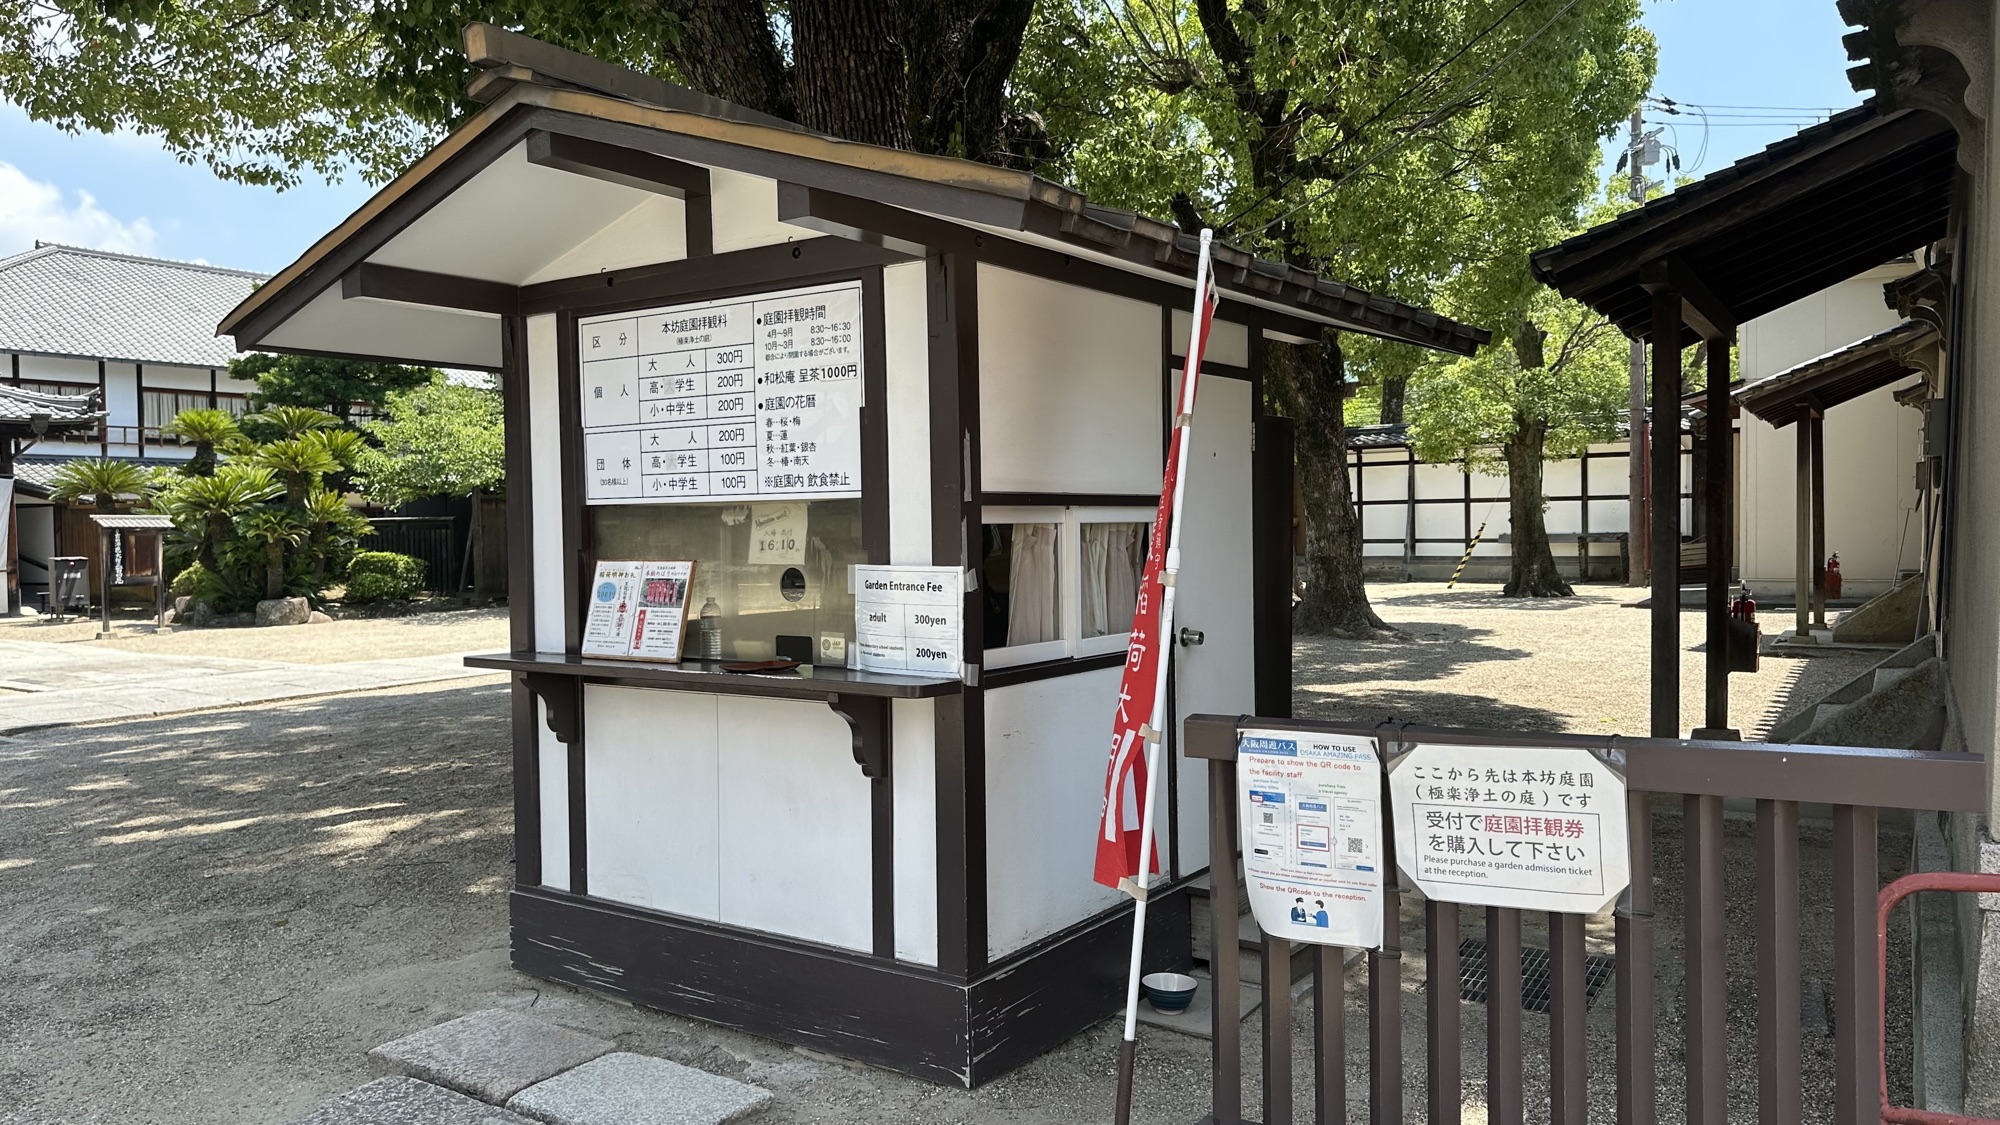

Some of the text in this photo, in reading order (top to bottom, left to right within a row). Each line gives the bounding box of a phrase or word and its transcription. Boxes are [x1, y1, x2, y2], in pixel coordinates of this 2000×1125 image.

[763, 305, 826, 326] 庭園拝観時間
[661, 314, 727, 334] 本坊庭園拝観料
[592, 332, 628, 348] 区 分
[648, 354, 695, 372] 大 人
[716, 350, 743, 364] 300円
[717, 373, 743, 388] 200円
[593, 384, 629, 399] 個 人
[650, 401, 696, 417] 小・中学生
[717, 397, 744, 411] 200円
[765, 394, 816, 411] 庭園の花暦
[650, 431, 697, 447] 大 人
[718, 428, 745, 442] 200円
[596, 457, 632, 471] 団 体
[720, 452, 745, 465] 100円
[652, 477, 698, 492] 小・中学生
[721, 475, 746, 489] 100円
[807, 472, 850, 487] 飲食禁止
[865, 579, 943, 592] Garden Entrance Fee
[869, 612, 887, 623] adult
[914, 614, 947, 627] 300yen
[916, 647, 947, 660] 200yen
[1241, 738, 1296, 751] 大阪周遊パス
[1313, 743, 1330, 751] HOW
[1342, 745, 1356, 753] USE
[1300, 749, 1321, 757] OSAKA
[1323, 751, 1353, 760] AMAZING
[1249, 756, 1276, 766] Prepare
[1306, 759, 1318, 767] the
[1333, 762, 1351, 770] code
[1262, 769, 1284, 778] facility
[1414, 766, 1594, 789] ここから先は本坊庭園
[1415, 783, 1592, 808] （極楽浄土の庭）です
[1426, 810, 1584, 839] 受付で庭園拝観券
[1428, 834, 1585, 862] を購入して下さい
[1424, 855, 1448, 864] Please
[1450, 857, 1487, 869] purchase
[1494, 860, 1523, 871] garden
[1525, 863, 1567, 874] admission
[1568, 866, 1593, 876] ticket
[1433, 867, 1447, 875] the
[1448, 869, 1489, 879] reception.
[1259, 882, 1274, 891] Show
[1287, 886, 1312, 896] QRcode
[1334, 893, 1366, 902] reception.
